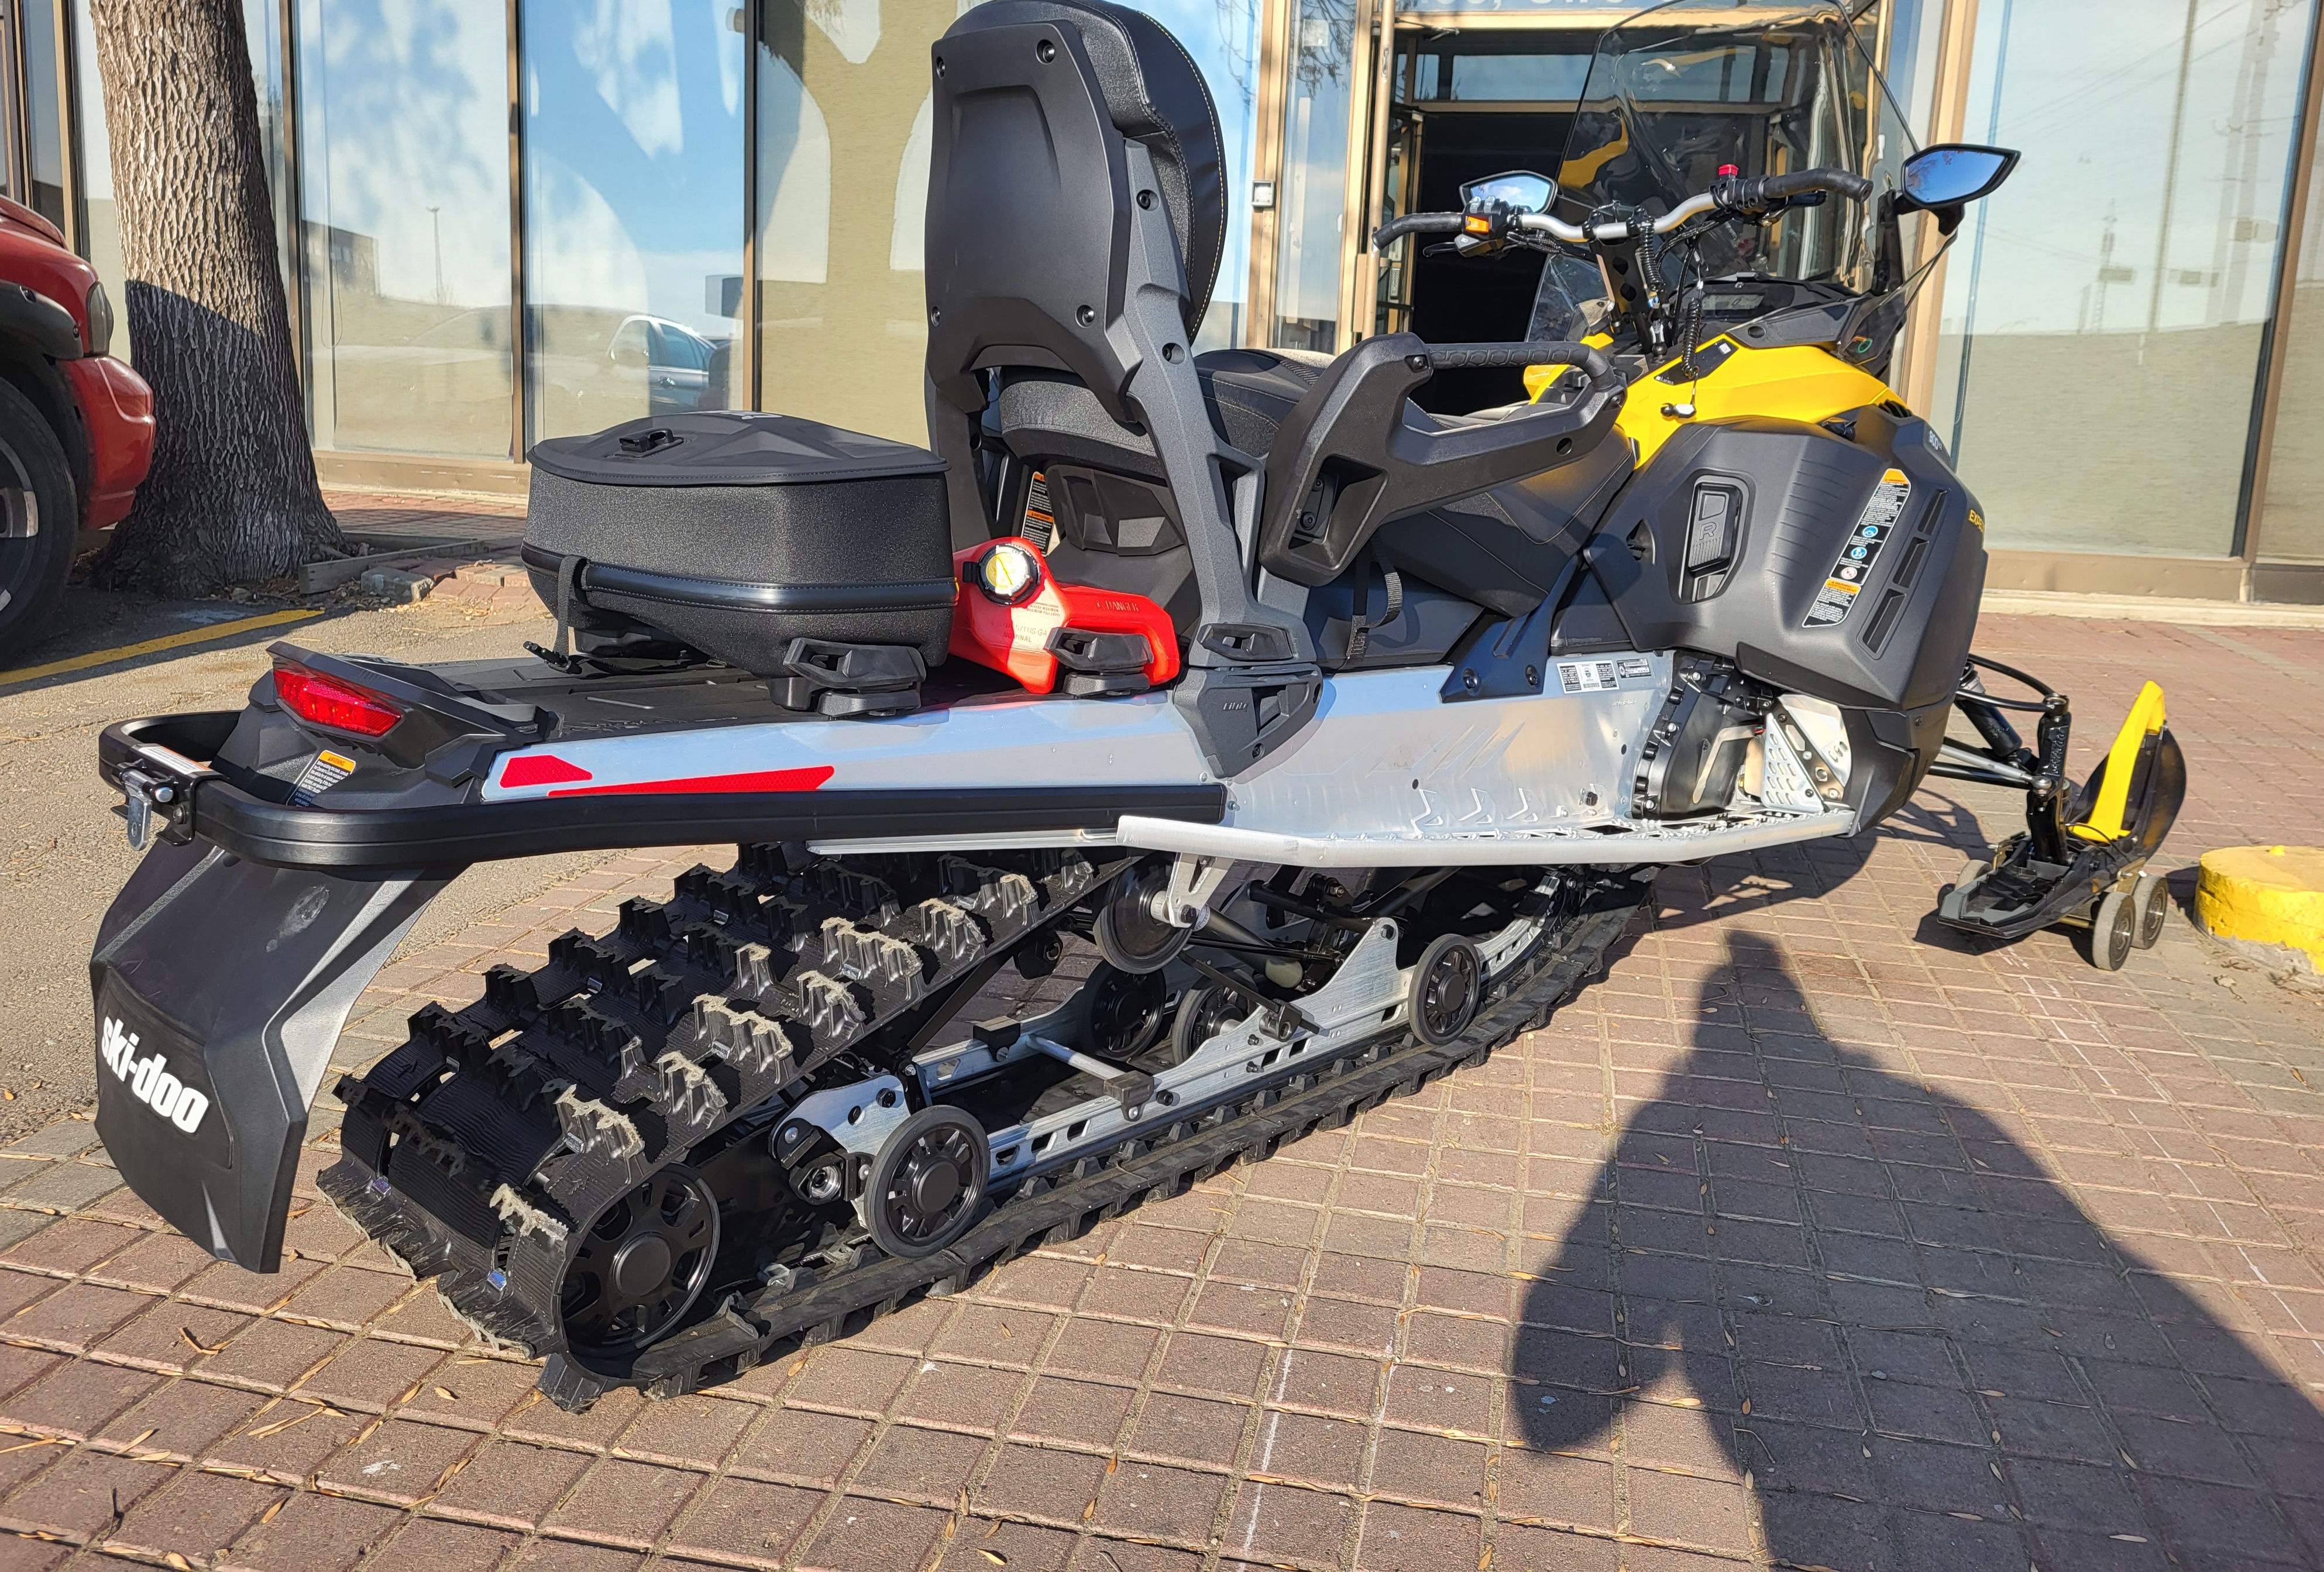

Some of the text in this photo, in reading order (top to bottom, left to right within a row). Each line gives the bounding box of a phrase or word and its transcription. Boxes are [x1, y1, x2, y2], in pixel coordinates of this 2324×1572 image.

[1105, 600, 1139, 612] DANGER
[1003, 632, 1032, 643] NOMINAL
[102, 1016, 209, 1133] ski-doo
